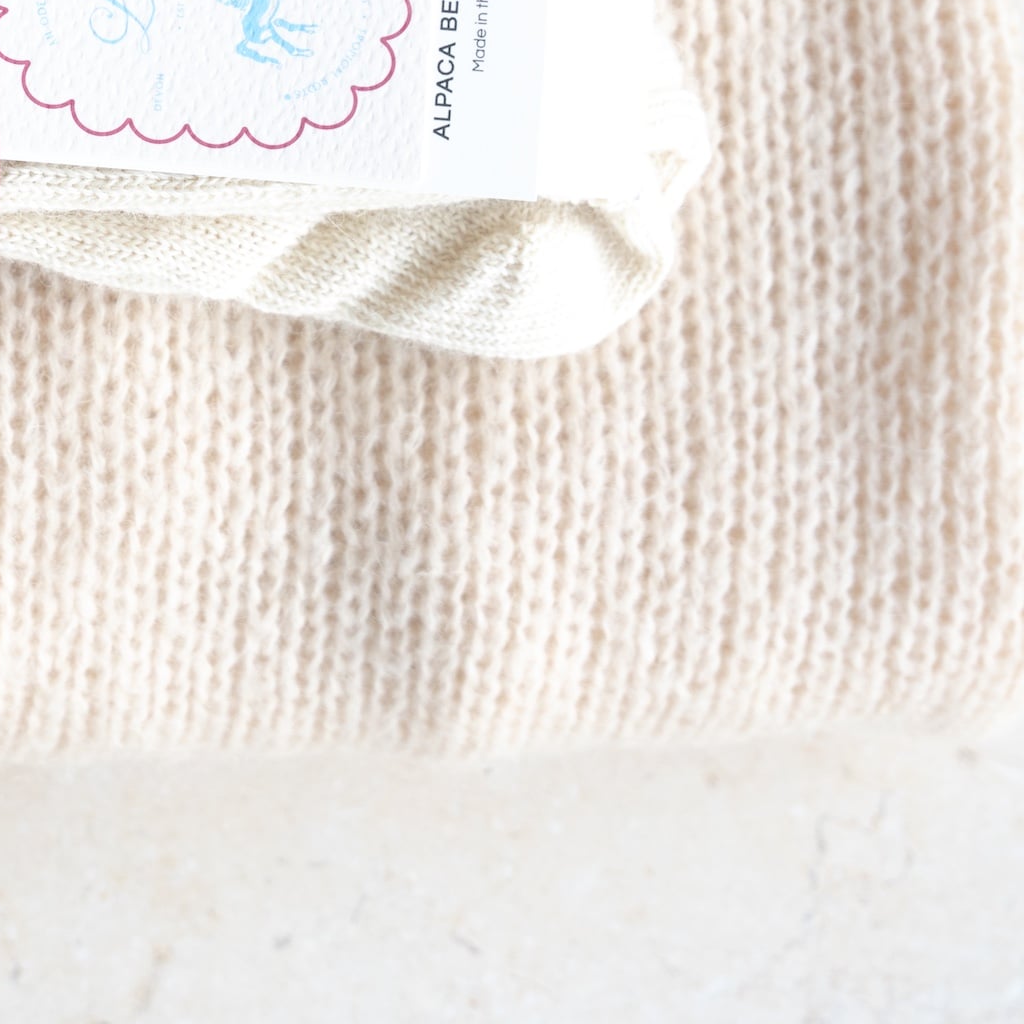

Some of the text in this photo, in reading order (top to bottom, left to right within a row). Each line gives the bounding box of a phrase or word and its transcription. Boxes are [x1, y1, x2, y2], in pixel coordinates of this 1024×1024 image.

[475, 9, 487, 26] in
[472, 29, 486, 72] Made
[153, 73, 165, 112] DEVON
[433, 42, 456, 140] ALPACA
